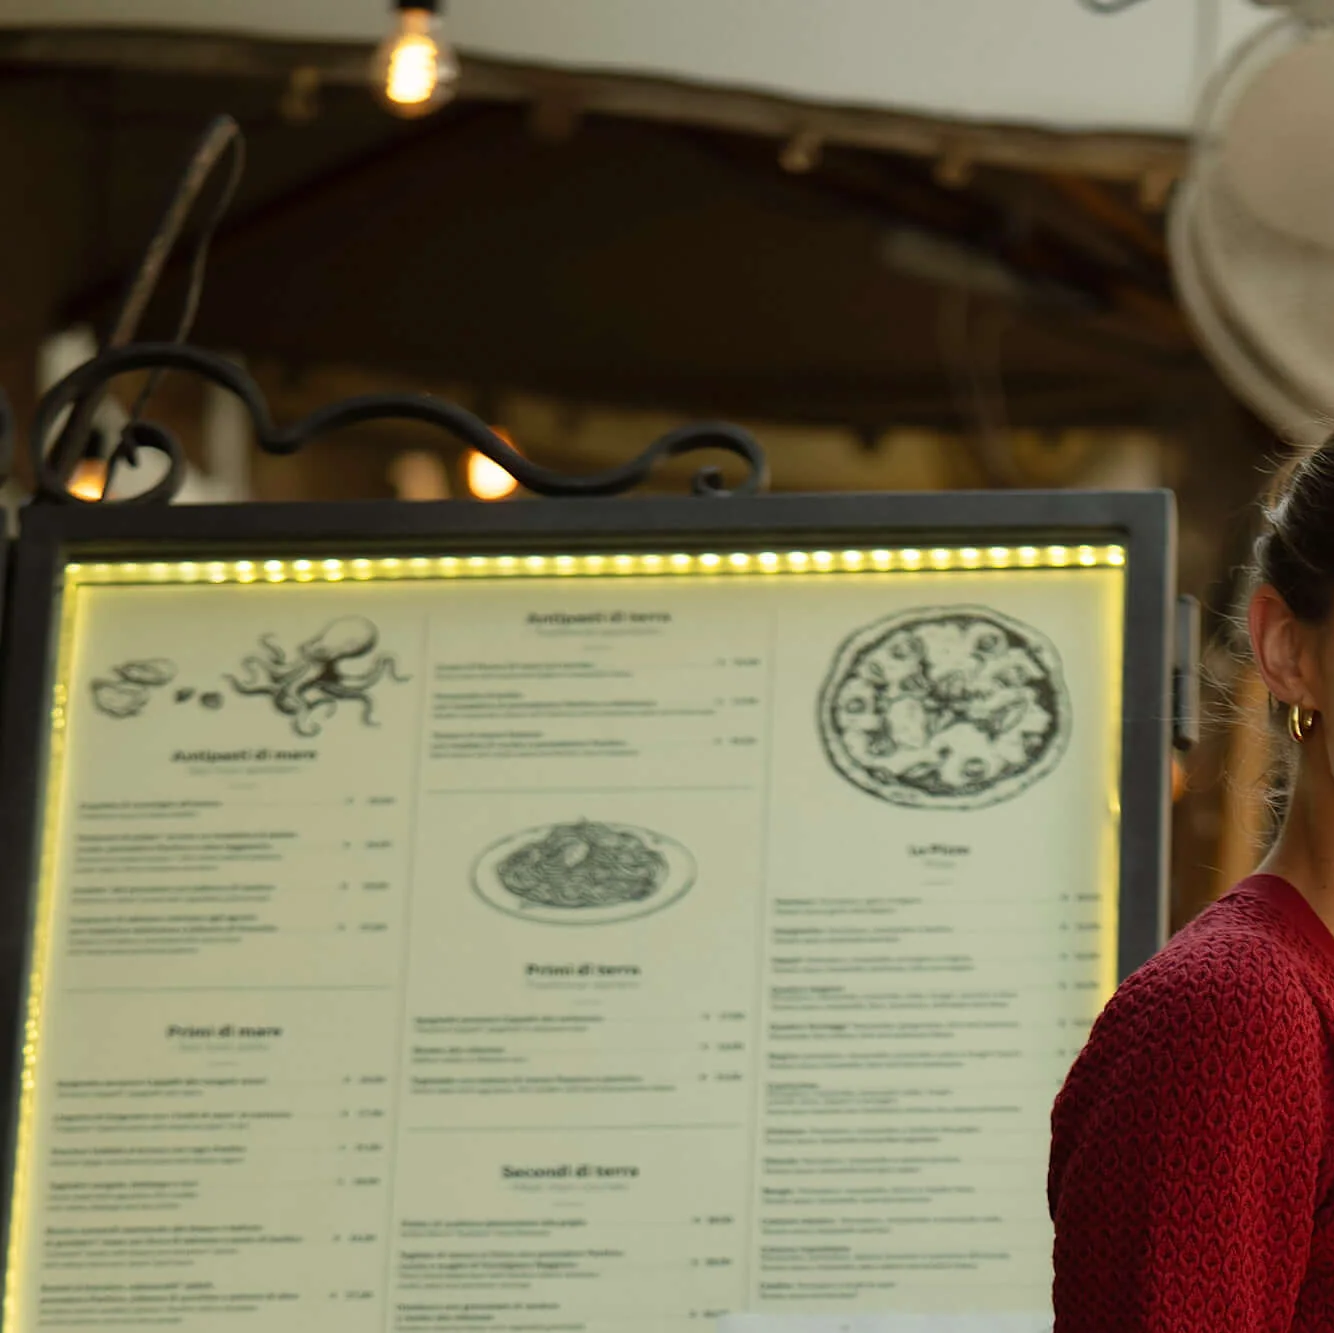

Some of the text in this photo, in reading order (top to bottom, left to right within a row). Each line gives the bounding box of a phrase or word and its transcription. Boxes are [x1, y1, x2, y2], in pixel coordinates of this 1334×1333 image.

[609, 610, 626, 624] di
[171, 748, 318, 763] Antipasti di mare
[526, 961, 642, 976] Primi di terra
[165, 1023, 283, 1038] Primi di mare
[501, 1163, 640, 1179] Secondi di terra
